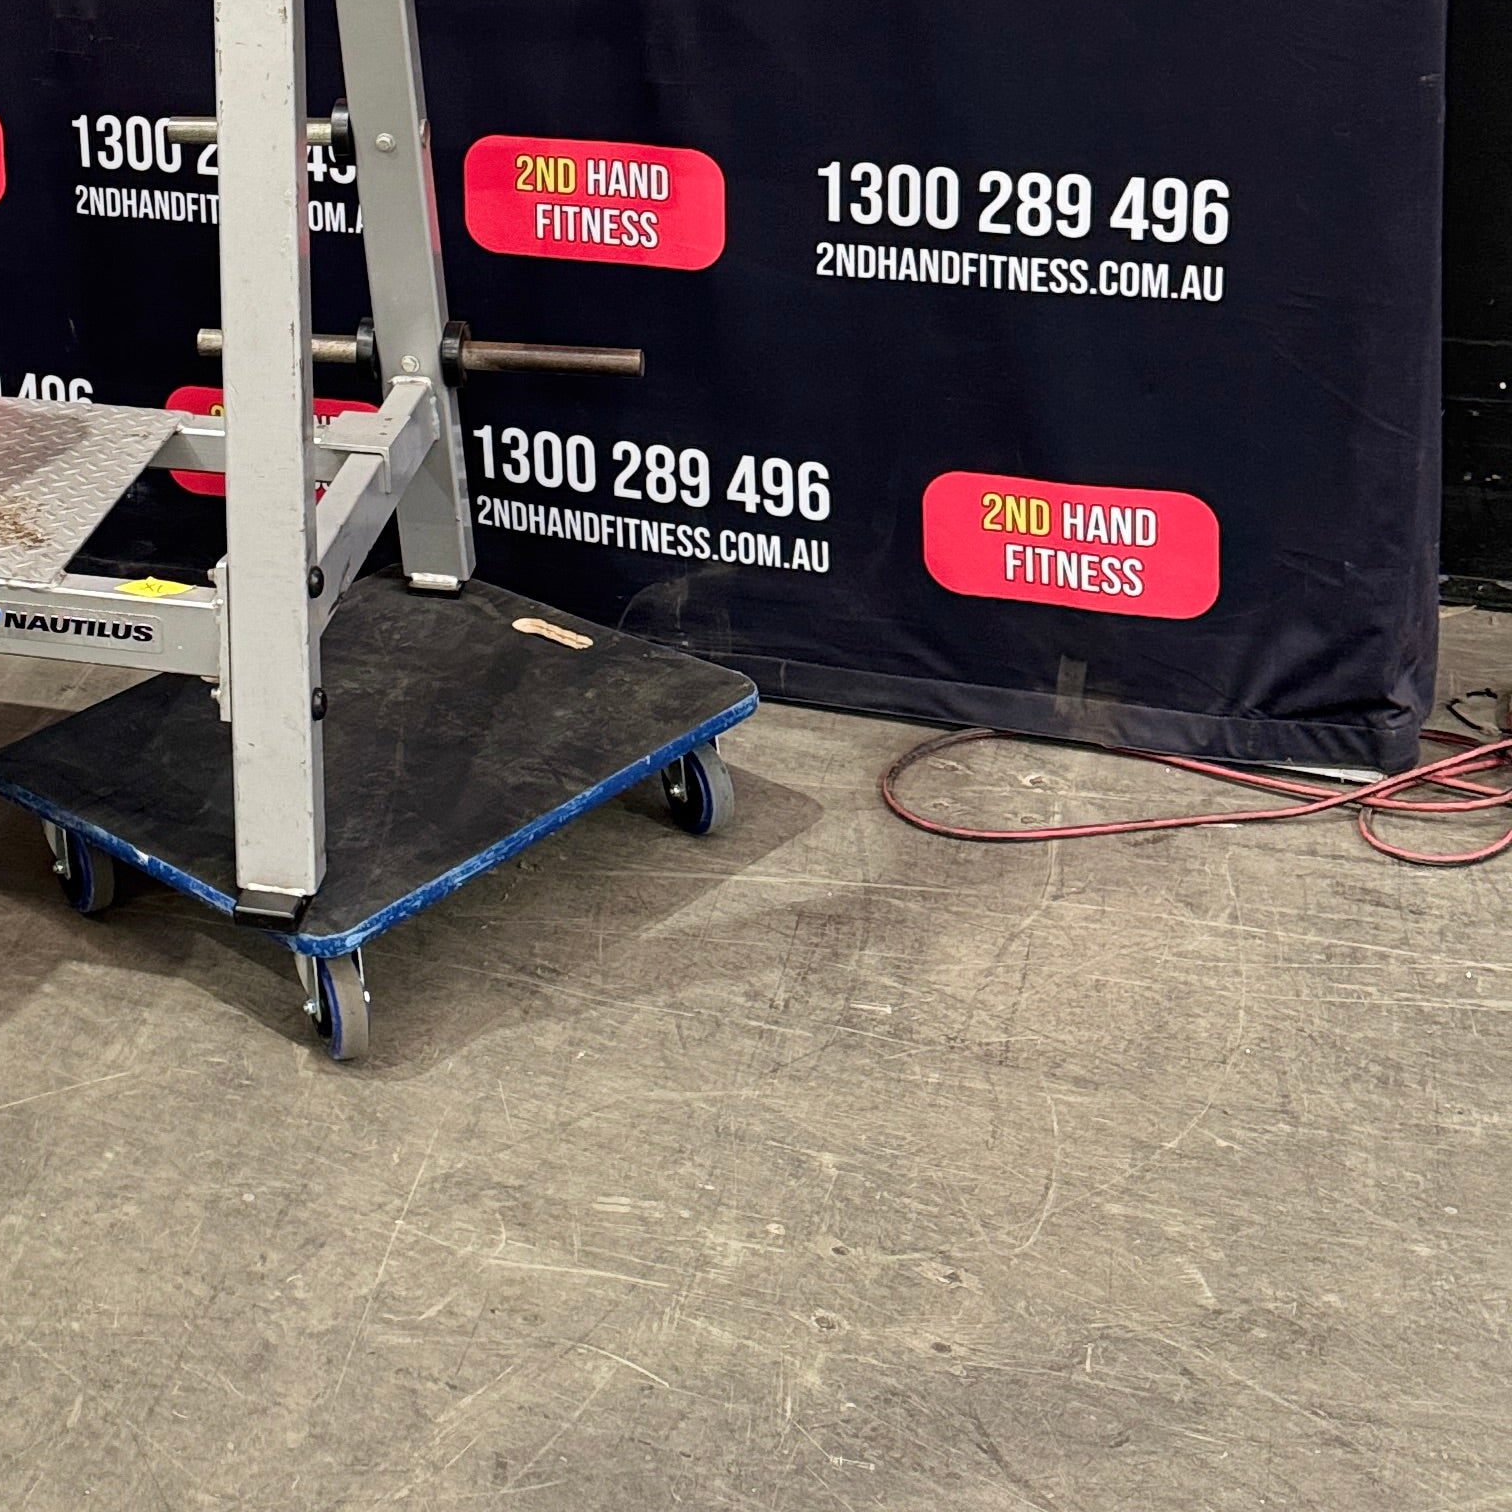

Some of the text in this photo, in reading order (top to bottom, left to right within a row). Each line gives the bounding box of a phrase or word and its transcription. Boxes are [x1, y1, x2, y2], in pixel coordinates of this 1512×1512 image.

[71, 114, 182, 174] 1300
[516, 155, 669, 201] 2ND HAND
[817, 161, 1230, 245] 1300 289 496
[536, 203, 658, 248] FITNESS
[816, 241, 1224, 302] 2NDHANDFITNESS.COM.AU
[473, 424, 830, 521] 1300 289 496
[476, 495, 830, 573] 2NDHANDFITNESS.COM.AU
[982, 493, 1157, 547] 2ND HAND
[1005, 543, 1143, 597] FITNESS
[4, 610, 155, 643] NAUTILUS
